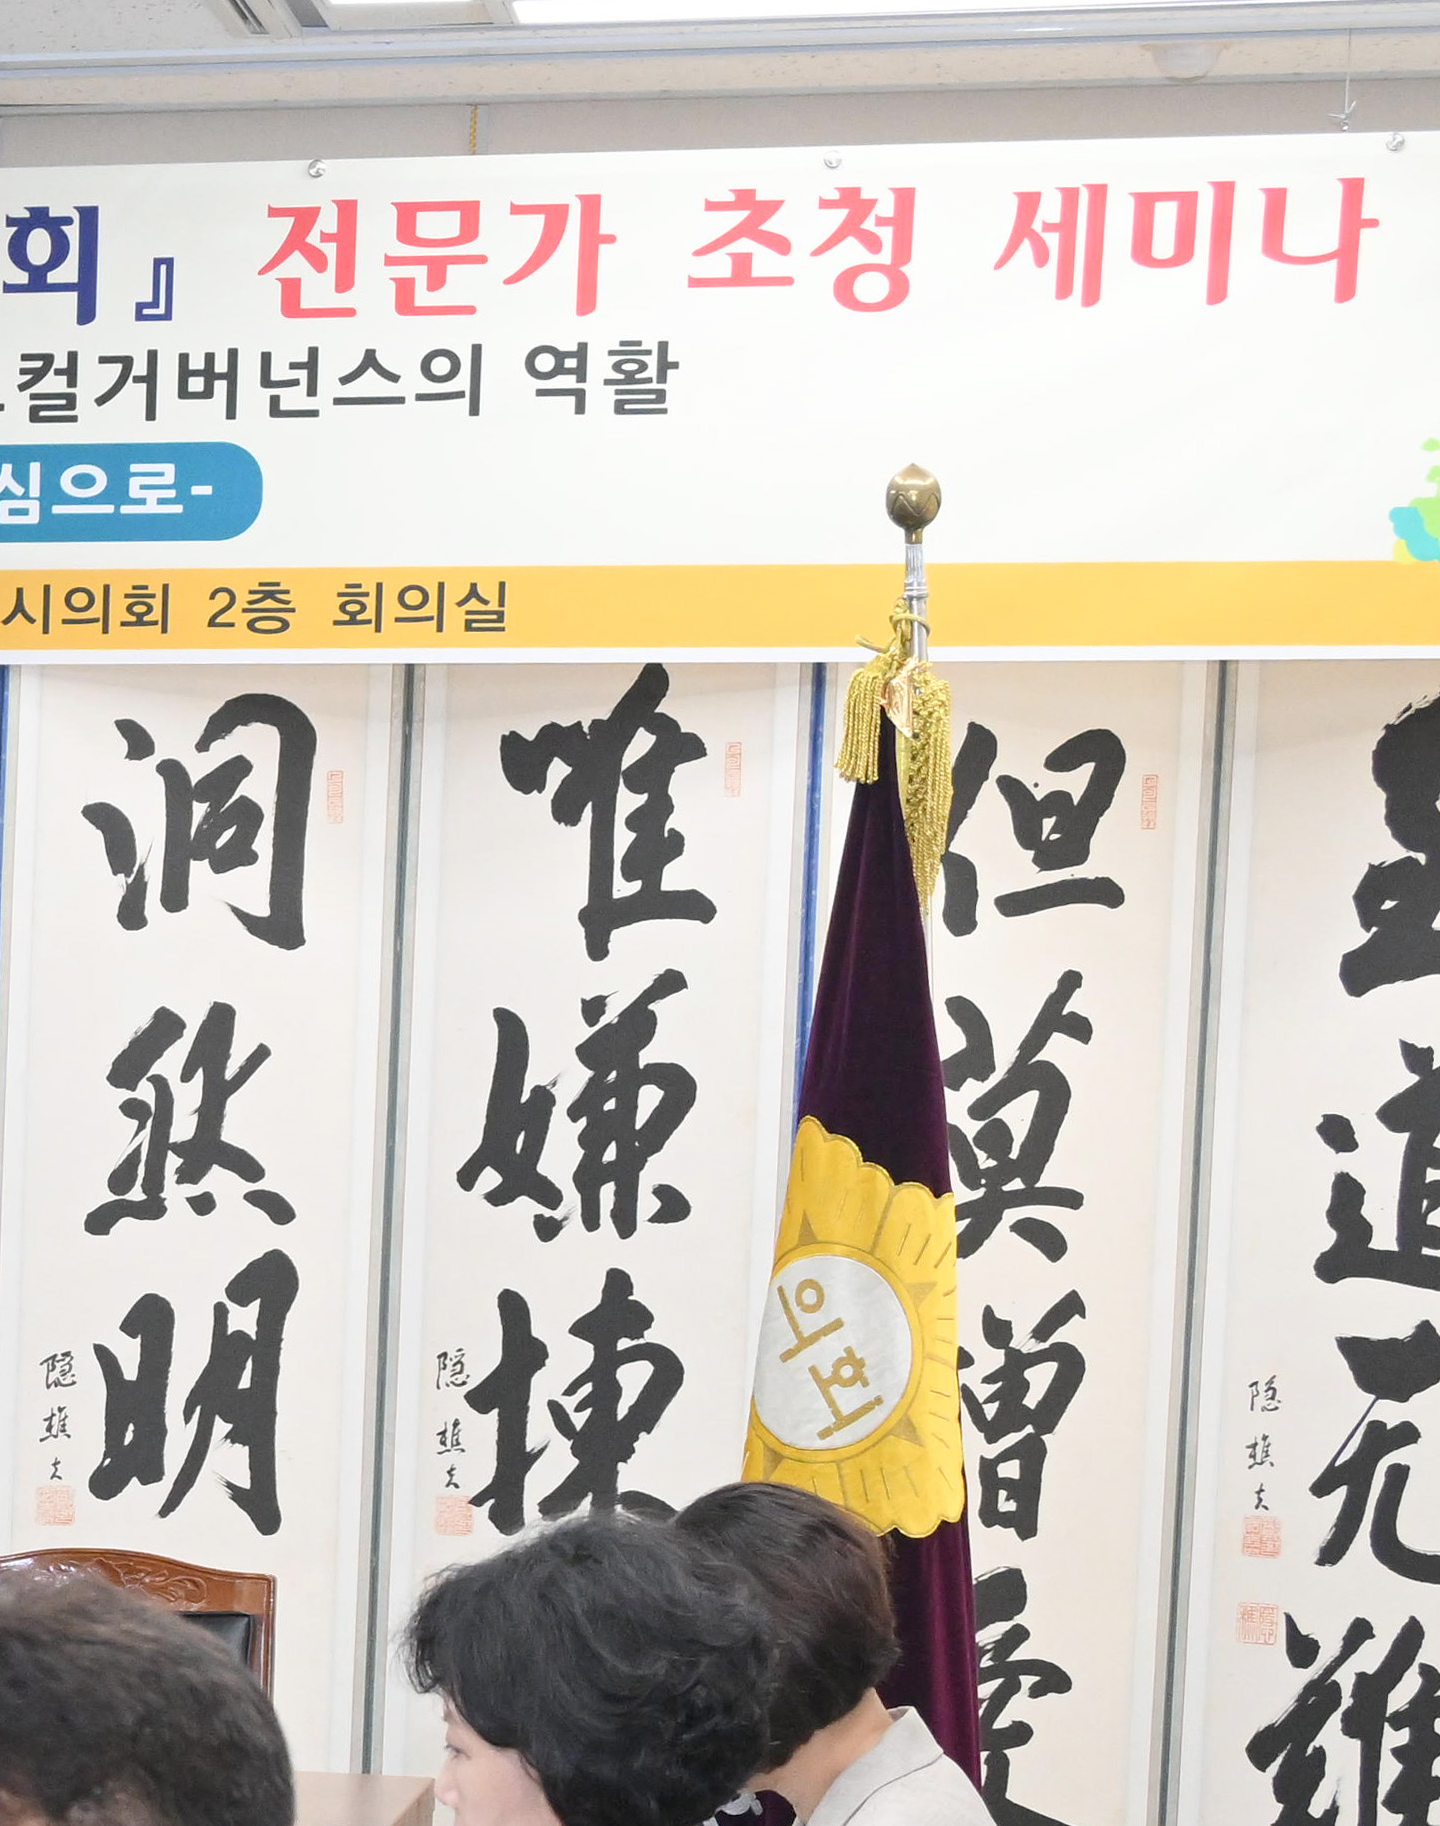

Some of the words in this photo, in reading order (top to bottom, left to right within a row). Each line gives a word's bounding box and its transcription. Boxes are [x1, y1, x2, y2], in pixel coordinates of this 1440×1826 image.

[258, 194, 618, 320] 전문가
[689, 187, 917, 314] 초청
[994, 178, 1381, 309] 세미나
[525, 340, 680, 416] 역활
[208, 582, 297, 636] 2층
[333, 581, 507, 634] 회의실
[776, 1277, 885, 1441] 의회
